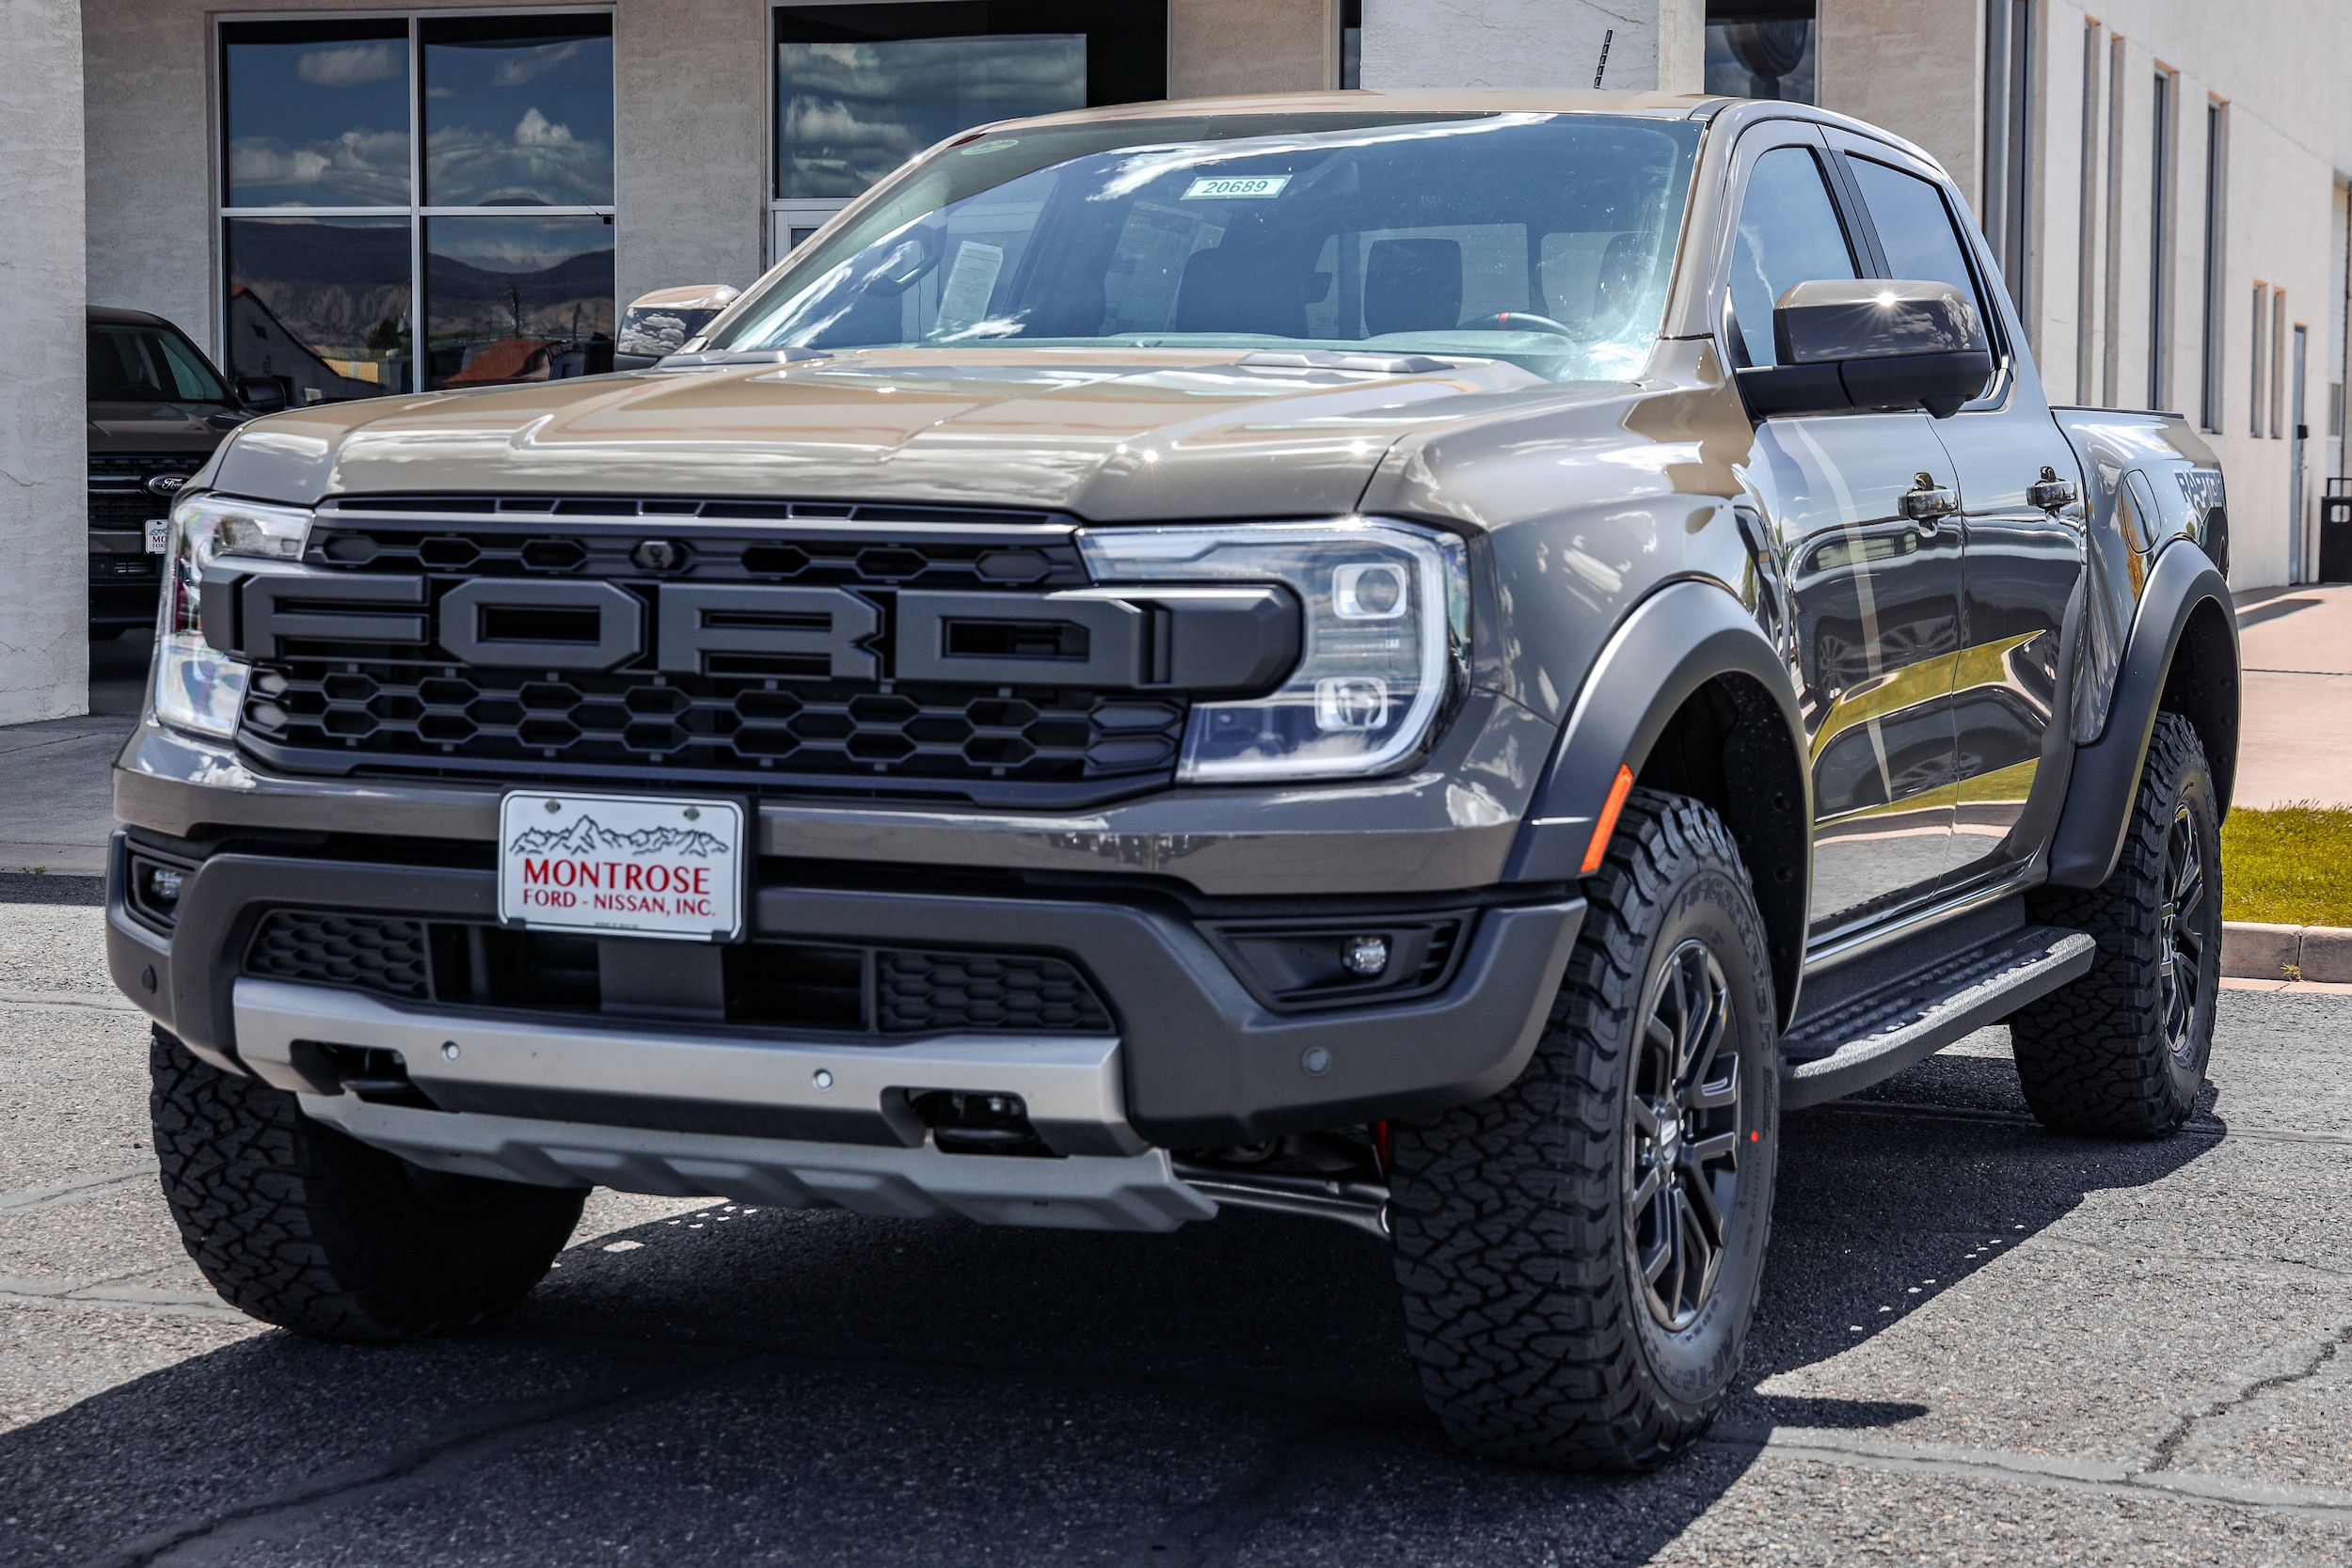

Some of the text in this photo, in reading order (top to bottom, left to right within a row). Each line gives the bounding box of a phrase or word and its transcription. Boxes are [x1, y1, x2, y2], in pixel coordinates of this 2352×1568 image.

[1201, 180, 1268, 194] 20689
[162, 478, 183, 490] For
[242, 573, 1144, 689] FORD
[523, 858, 711, 895] MONTROSE
[523, 889, 577, 909] FORD
[594, 894, 671, 917] NISSAN,
[675, 899, 717, 917] INC.
